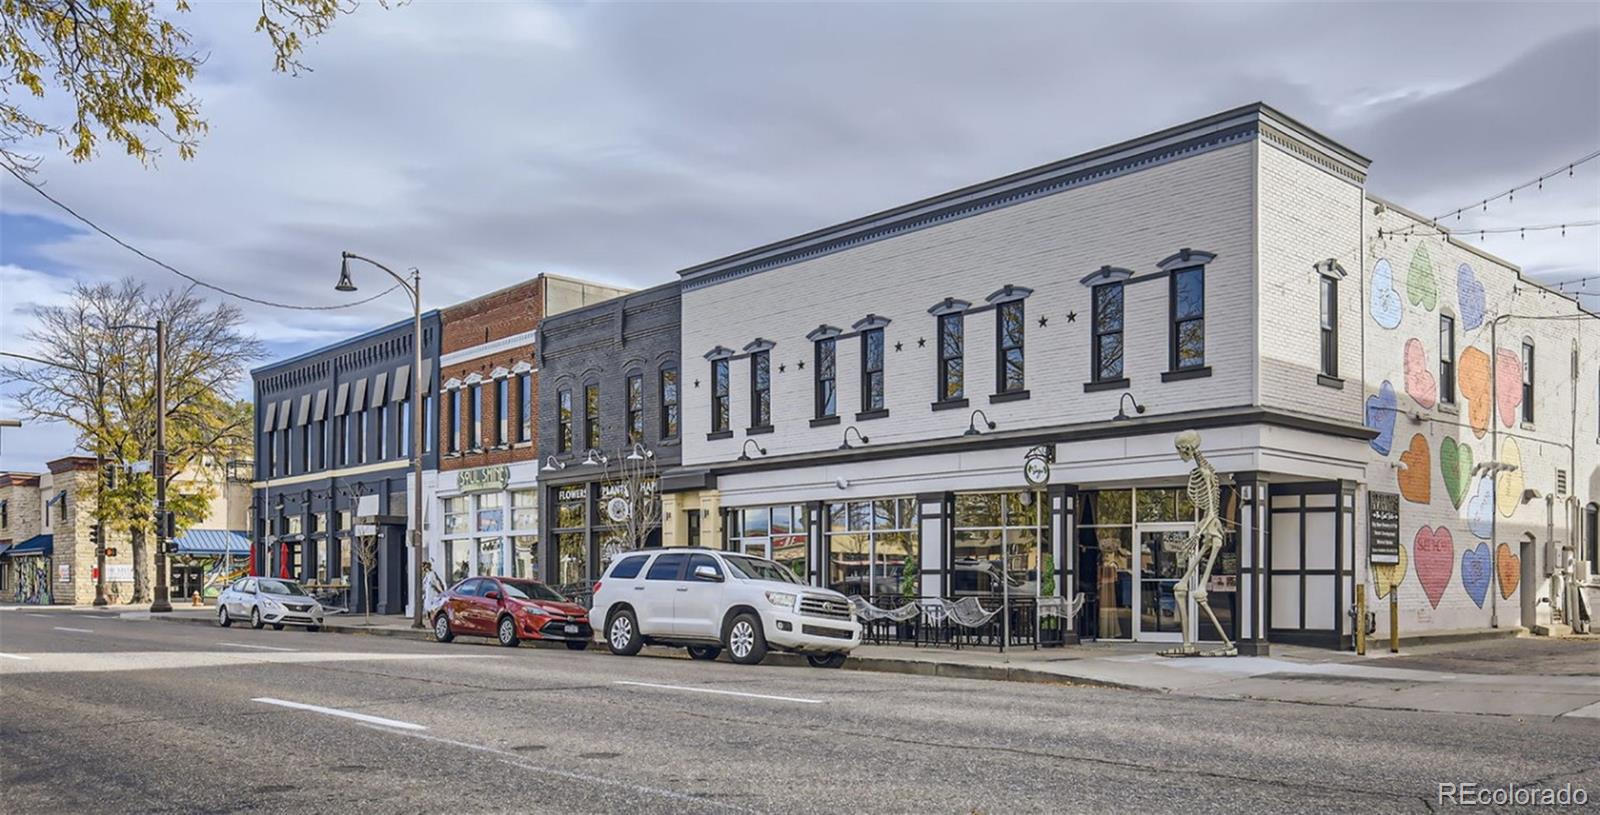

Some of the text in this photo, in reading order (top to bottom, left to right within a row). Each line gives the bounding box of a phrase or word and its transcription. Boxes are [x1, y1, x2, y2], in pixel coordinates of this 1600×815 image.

[459, 466, 504, 486] SOUL SHINE
[558, 488, 587, 501] FLOWERS
